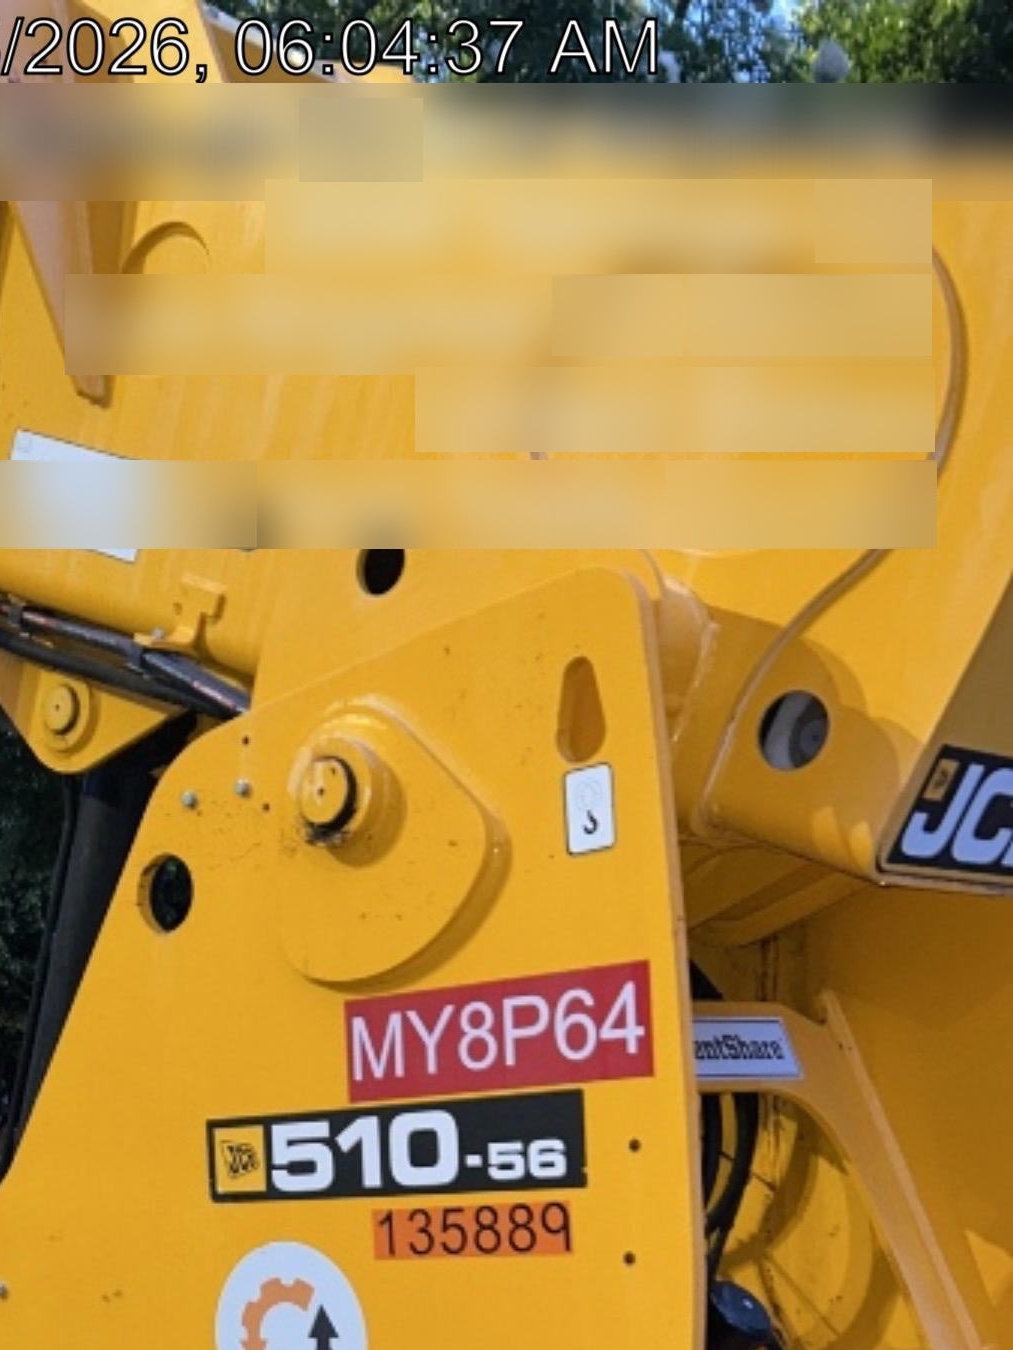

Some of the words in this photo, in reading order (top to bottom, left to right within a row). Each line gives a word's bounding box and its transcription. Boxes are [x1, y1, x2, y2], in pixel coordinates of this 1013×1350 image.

[901, 762, 1013, 867] JC
[351, 980, 645, 1081] MY8P64
[271, 1109, 567, 1192] 510-56
[379, 1202, 573, 1255] 135889
